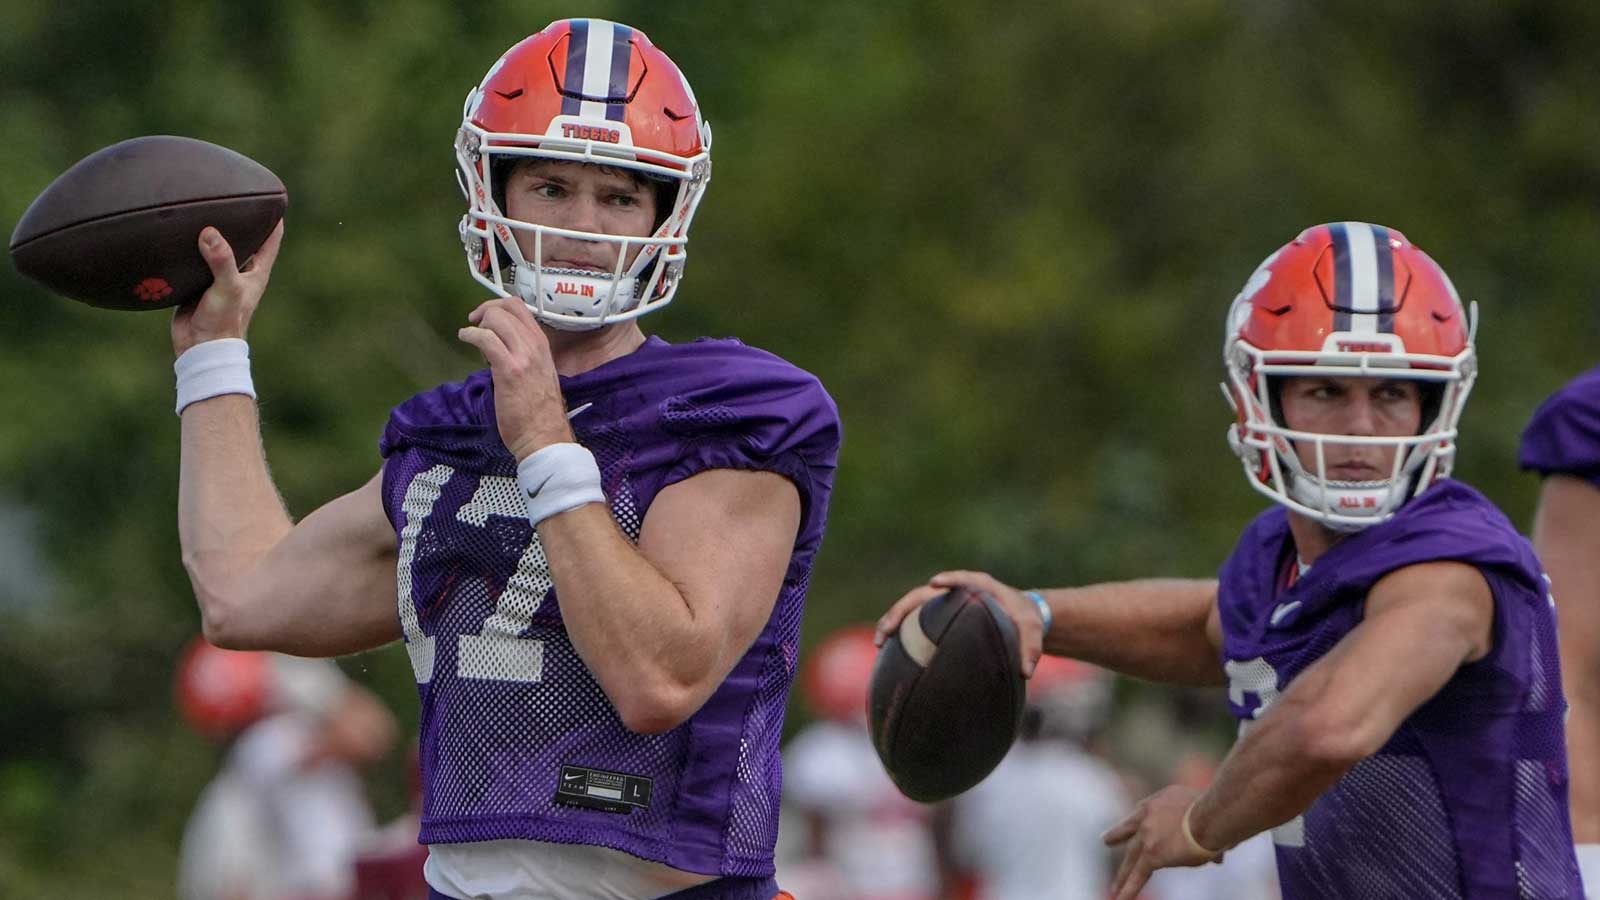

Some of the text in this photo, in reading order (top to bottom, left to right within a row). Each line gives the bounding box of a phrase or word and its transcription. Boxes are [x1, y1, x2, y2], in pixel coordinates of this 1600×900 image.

[561, 123, 620, 144] TIGERS
[554, 281, 594, 298] ALL IN
[1338, 495, 1361, 509] ALL
[397, 463, 555, 683] 17
[633, 784, 641, 797] L
